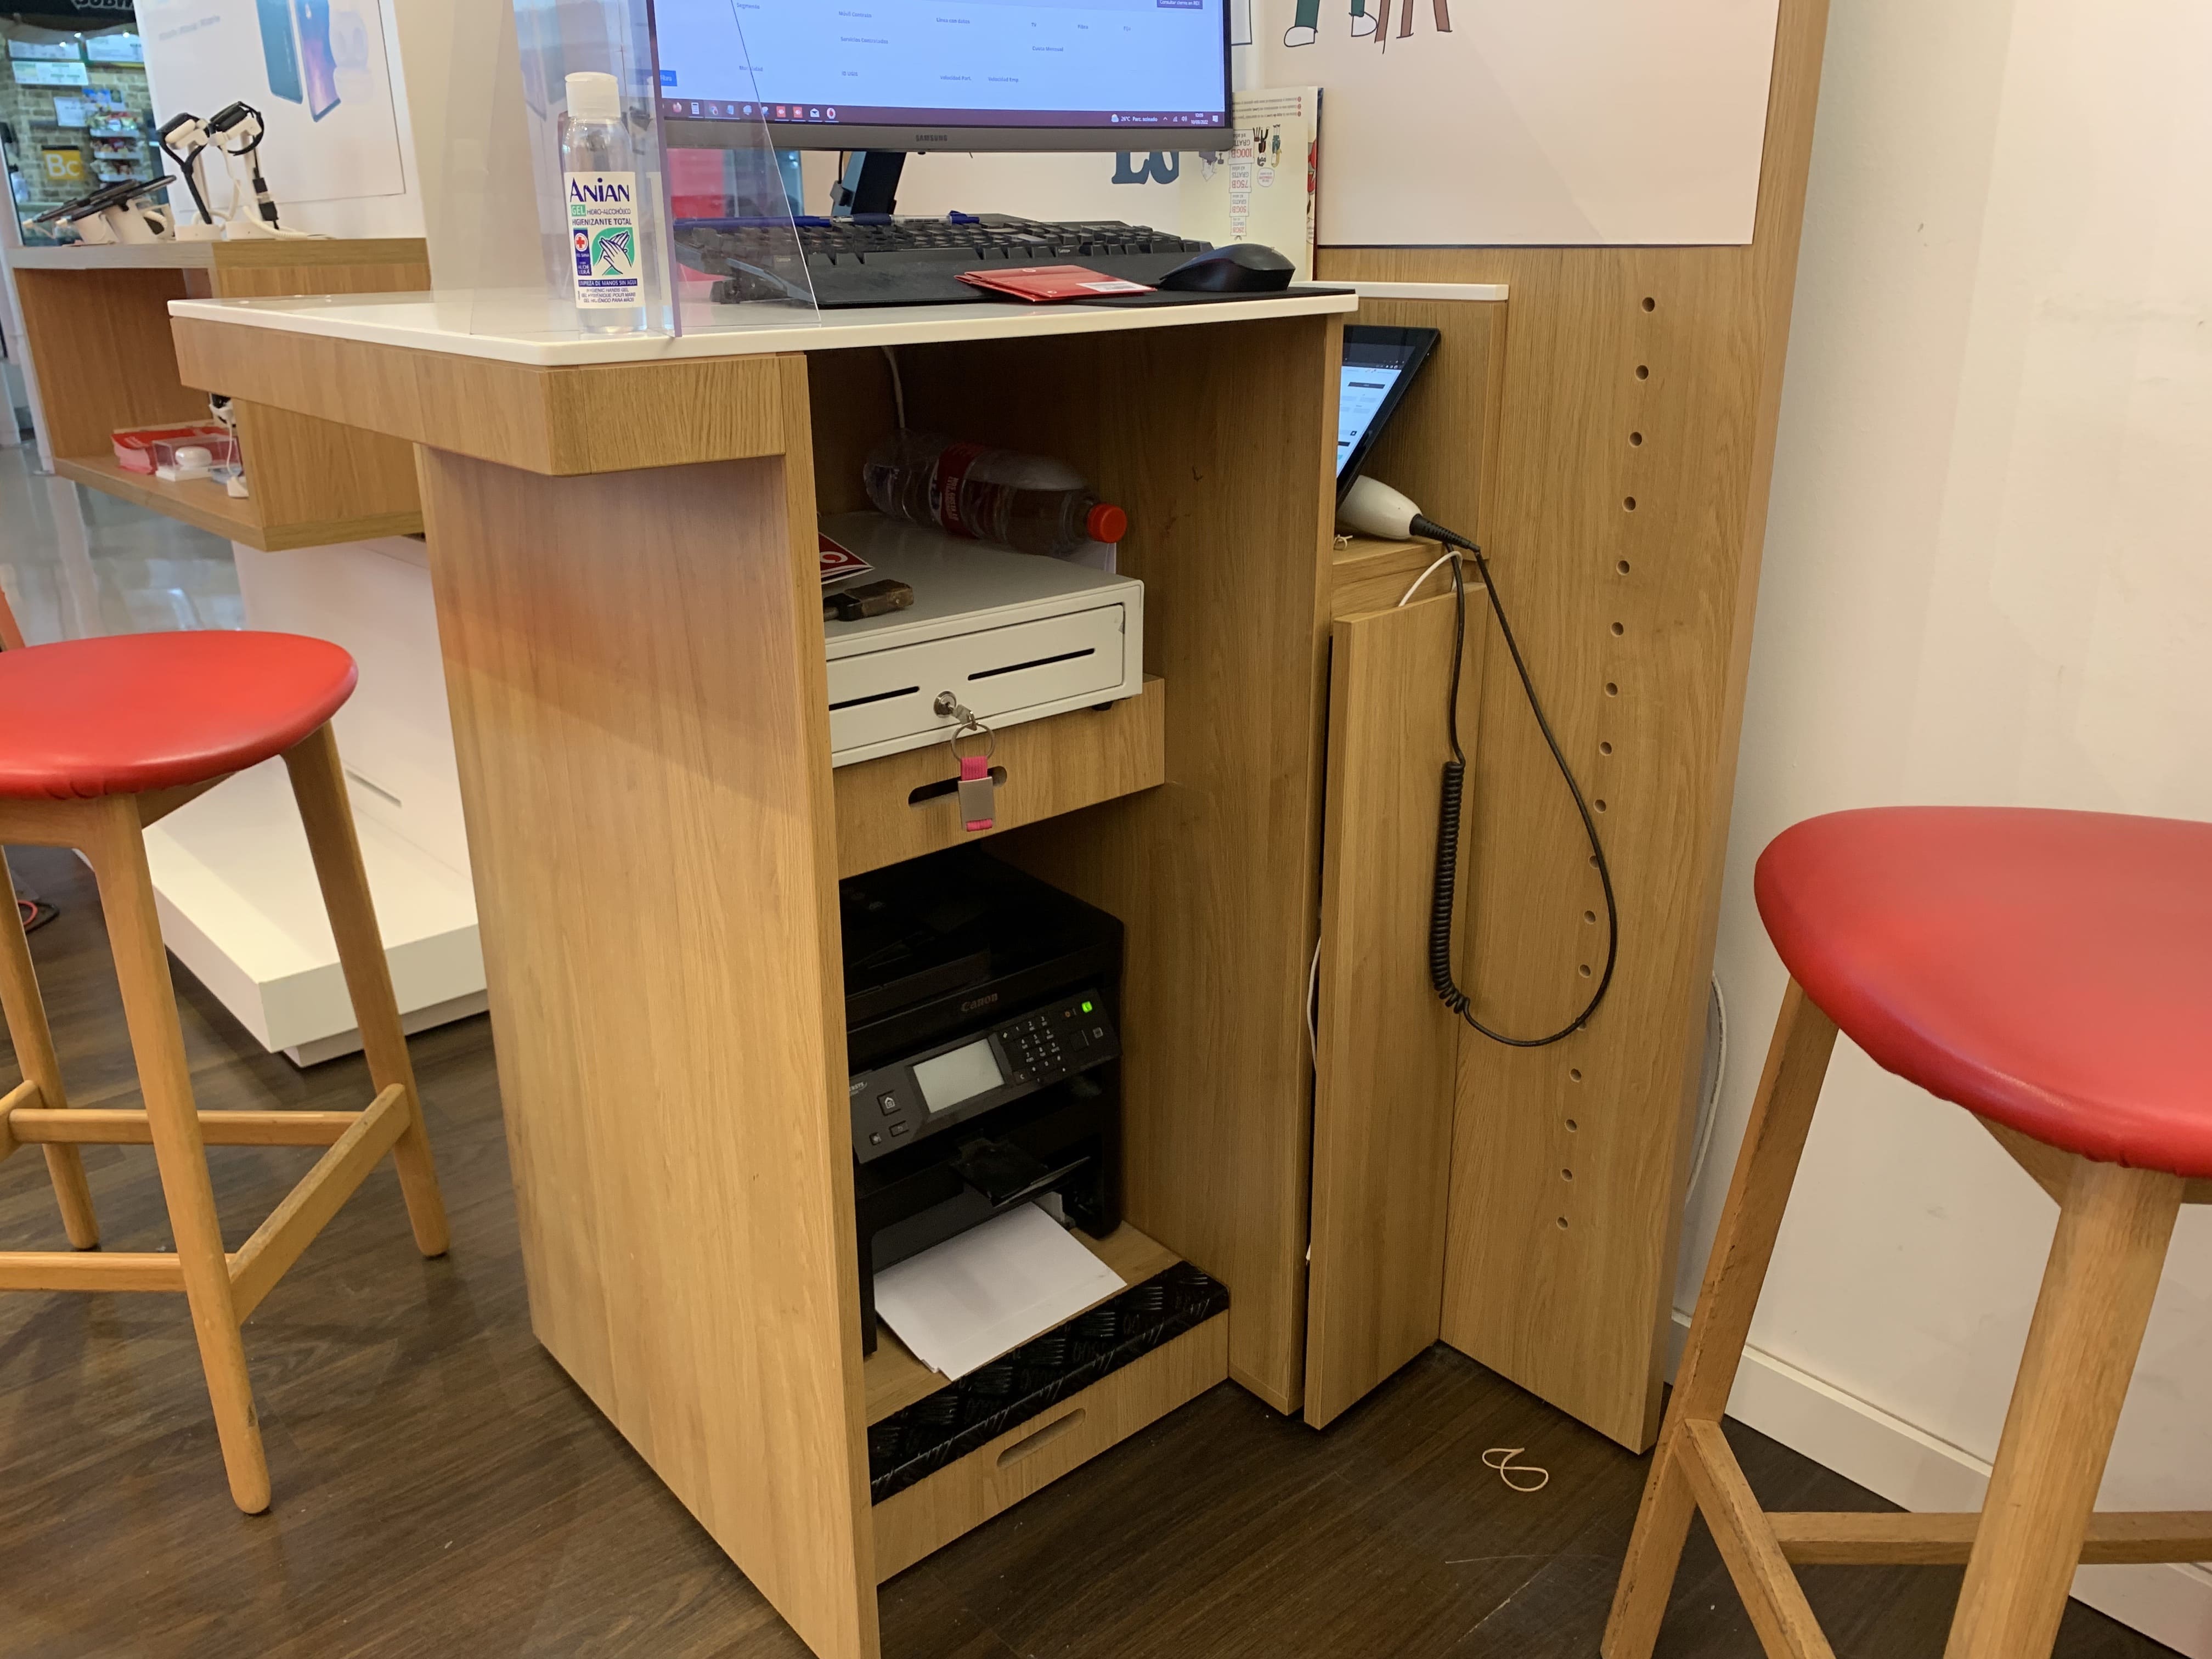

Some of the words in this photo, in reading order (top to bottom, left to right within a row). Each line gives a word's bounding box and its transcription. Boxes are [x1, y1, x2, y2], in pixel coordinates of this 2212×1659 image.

[1231, 148, 1252, 158] 100GB
[1232, 180, 1248, 188] 75GB
[572, 206, 585, 215] GEL
[961, 992, 998, 1013] Canon
